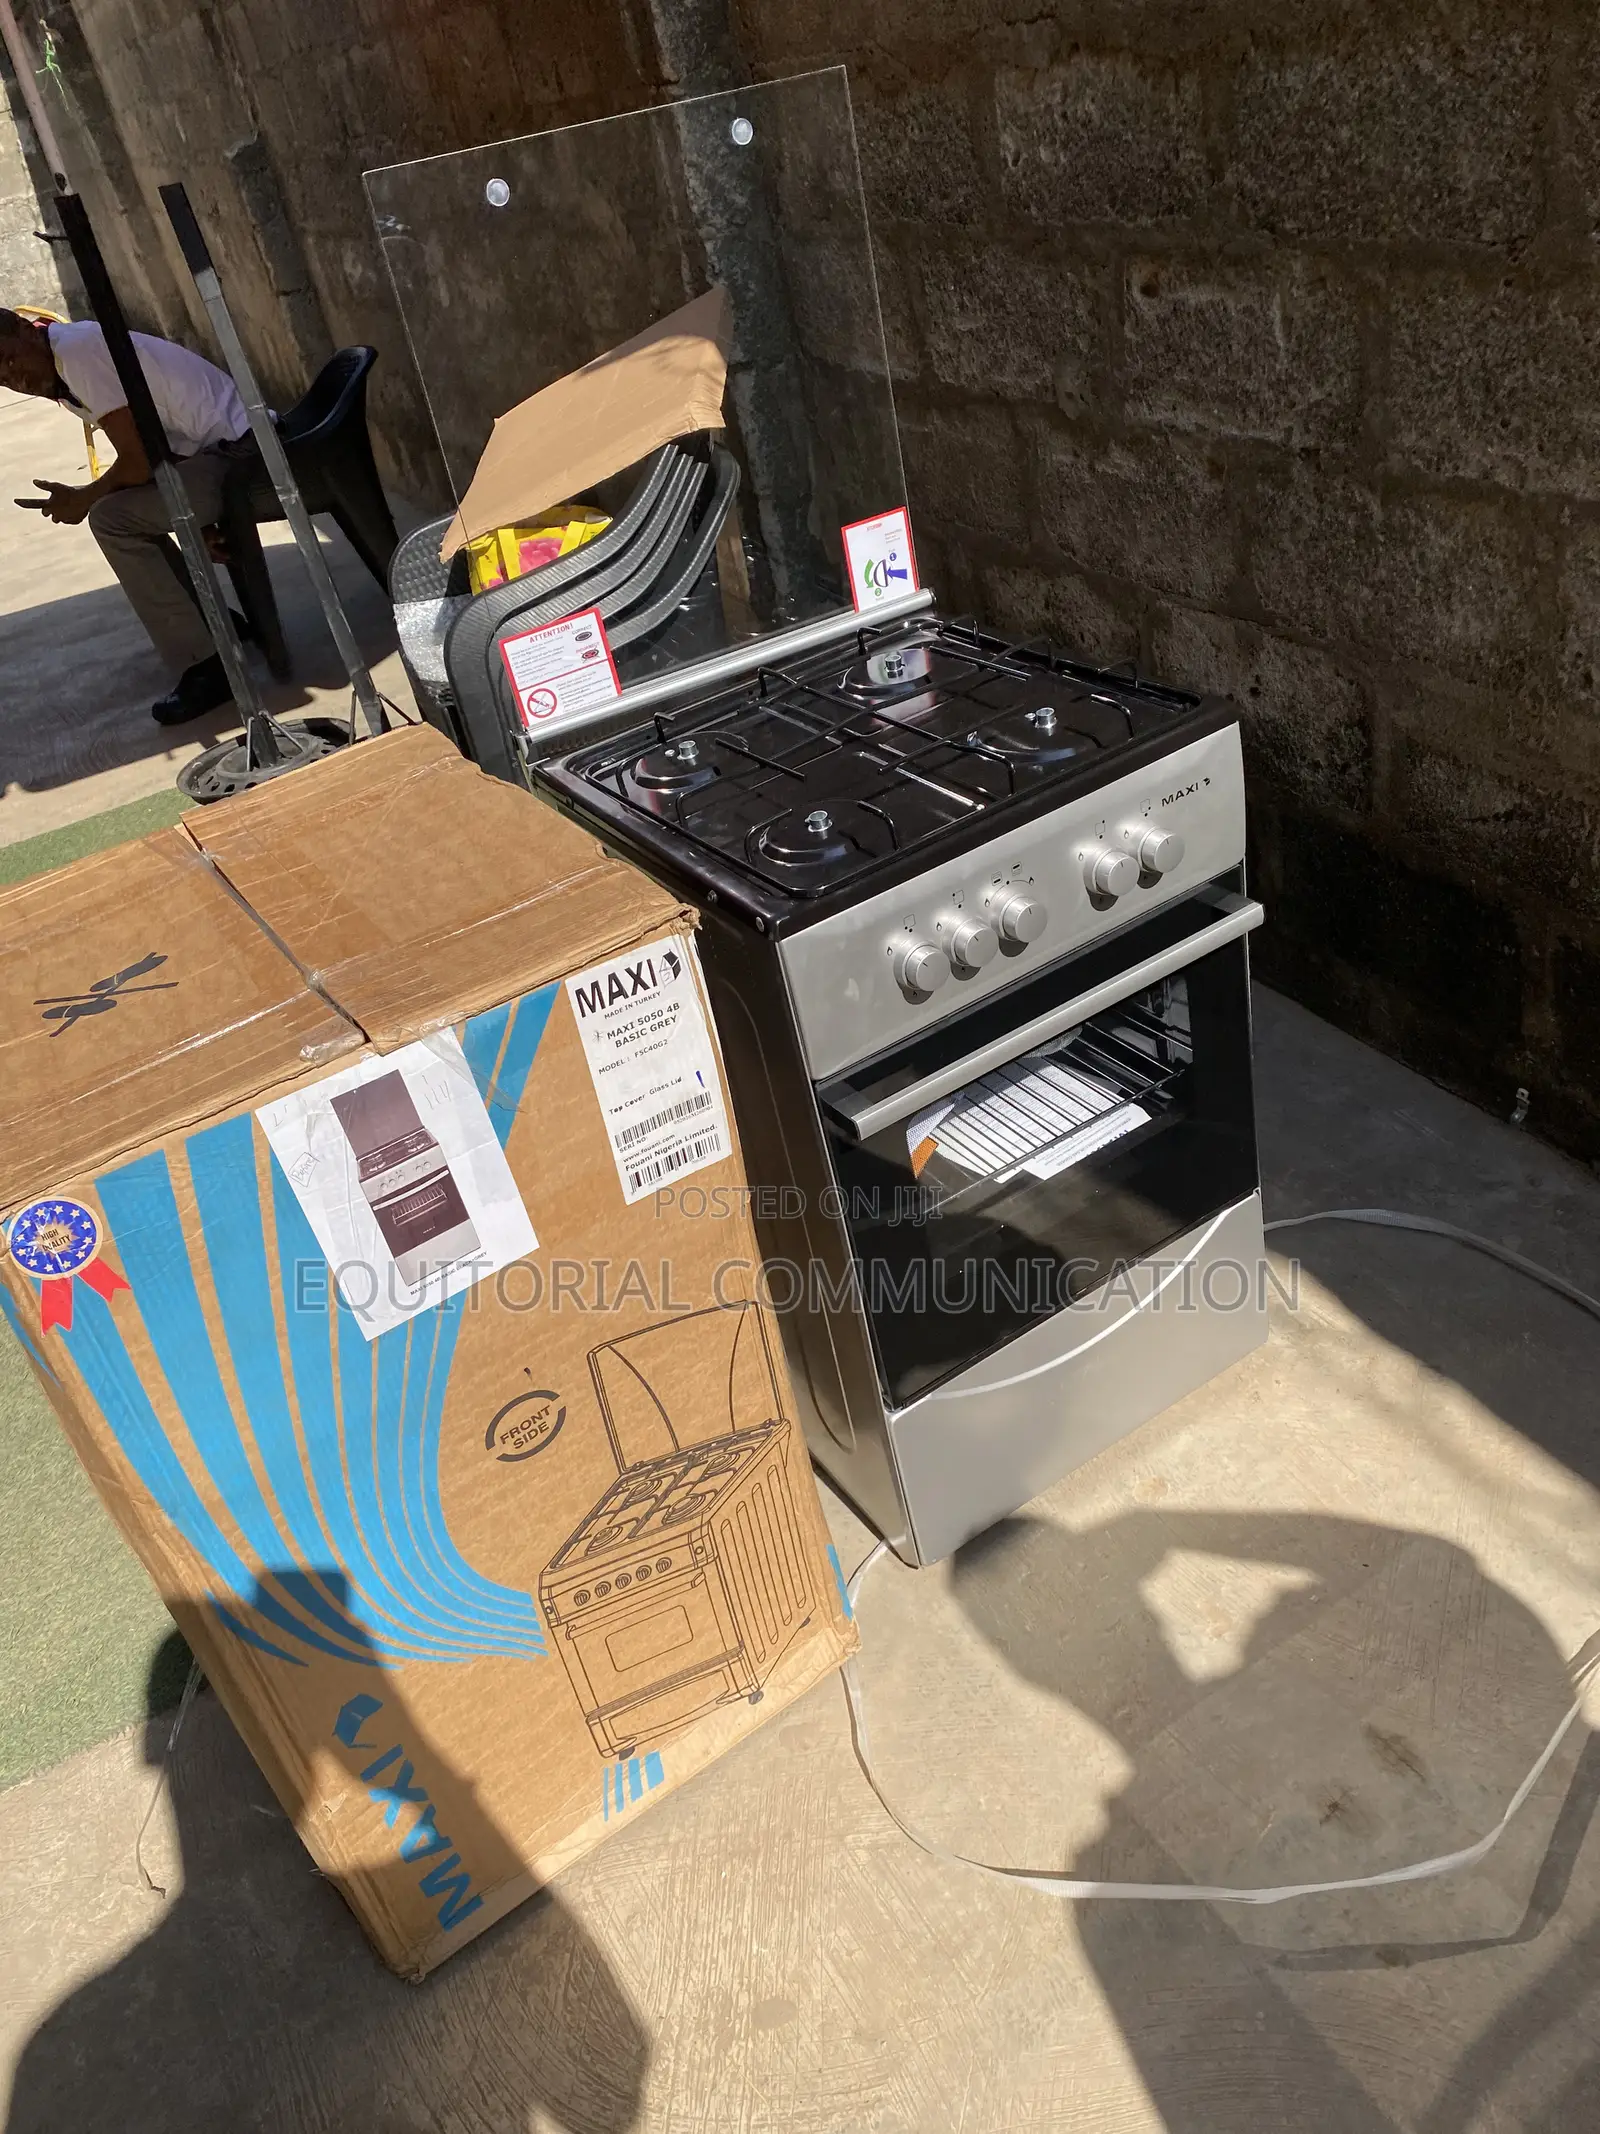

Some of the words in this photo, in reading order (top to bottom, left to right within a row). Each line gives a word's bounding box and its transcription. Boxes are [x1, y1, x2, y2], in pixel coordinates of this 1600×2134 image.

[529, 622, 573, 643] ATTENTION!
[1161, 782, 1199, 807] MAXI
[575, 958, 658, 1018] MAXI
[604, 1008, 623, 1019] MADE
[634, 991, 661, 1006] TURKEY
[606, 1022, 635, 1040] MAXI
[637, 1009, 664, 1026] 5050
[666, 1002, 680, 1013] 4B
[615, 1028, 648, 1048] BASIC
[649, 1015, 677, 1032] GREY
[609, 1105, 623, 1115] Top
[624, 1094, 646, 1108] Cover
[649, 1083, 669, 1095] Glass
[670, 1076, 682, 1086] Lid
[623, 1133, 676, 1163] www.fouani.com
[625, 1154, 653, 1171] Fouani
[654, 1139, 683, 1158] Nigeria
[684, 1124, 718, 1142] Limited.
[41, 1229, 59, 1241] HIGH
[500, 1404, 551, 1445] FRONT
[513, 1421, 550, 1449] SIDE
[360, 1743, 485, 1932] MAXI
